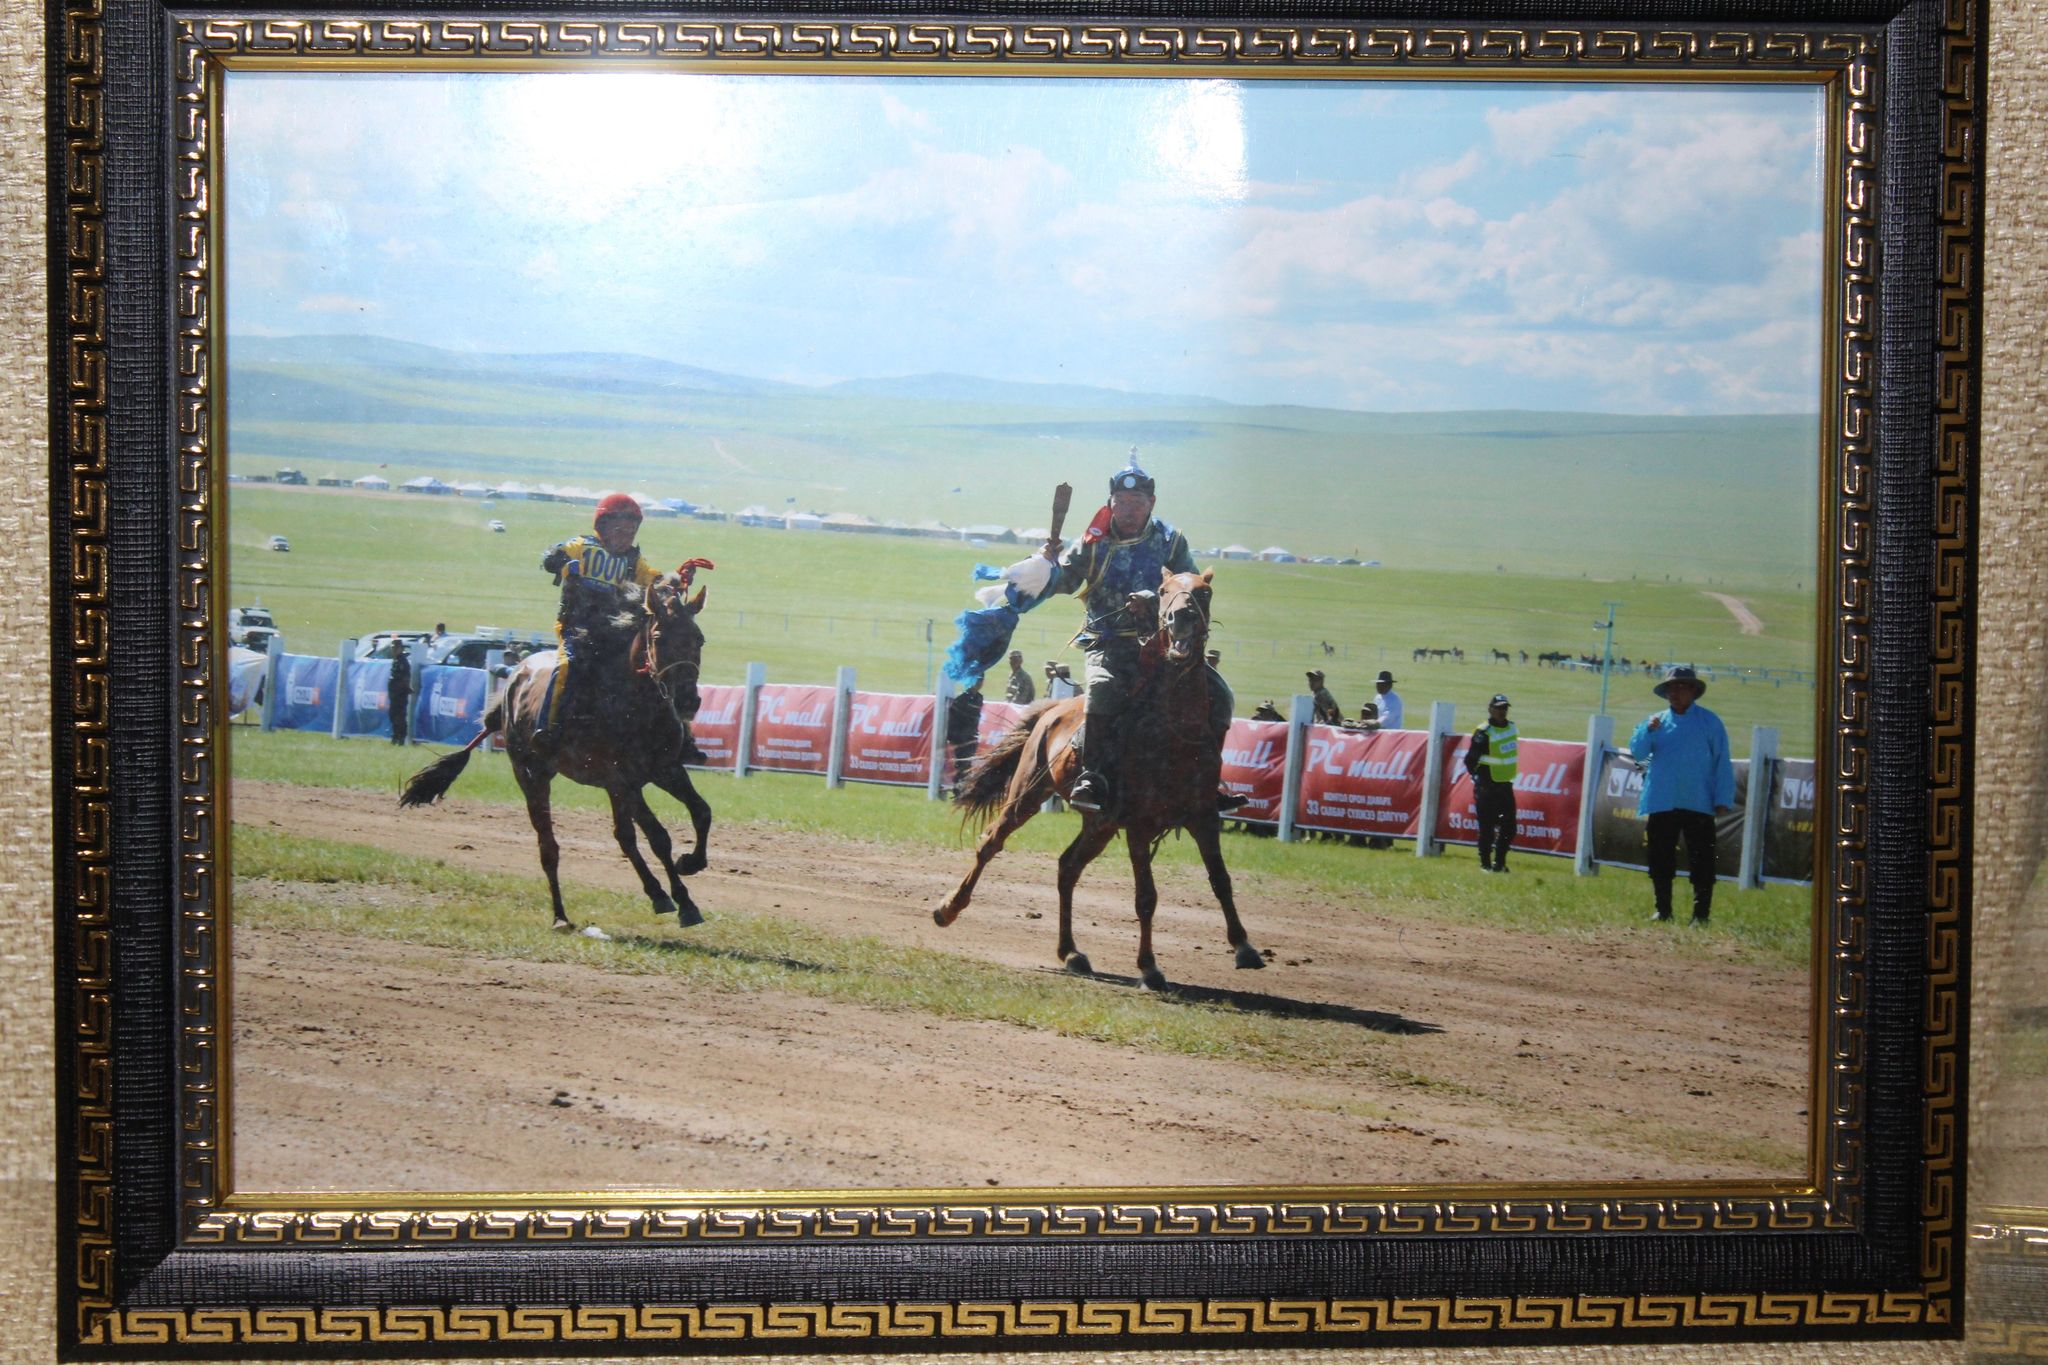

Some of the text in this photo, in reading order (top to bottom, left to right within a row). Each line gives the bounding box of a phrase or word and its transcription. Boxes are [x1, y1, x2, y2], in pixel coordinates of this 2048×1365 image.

[582, 547, 628, 583] 1000
[758, 695, 825, 727] PC mall
[850, 703, 924, 737] PC mall
[1307, 739, 1412, 780] PC mall
[1306, 799, 1320, 815] 33
[1449, 813, 1462, 828] 33
